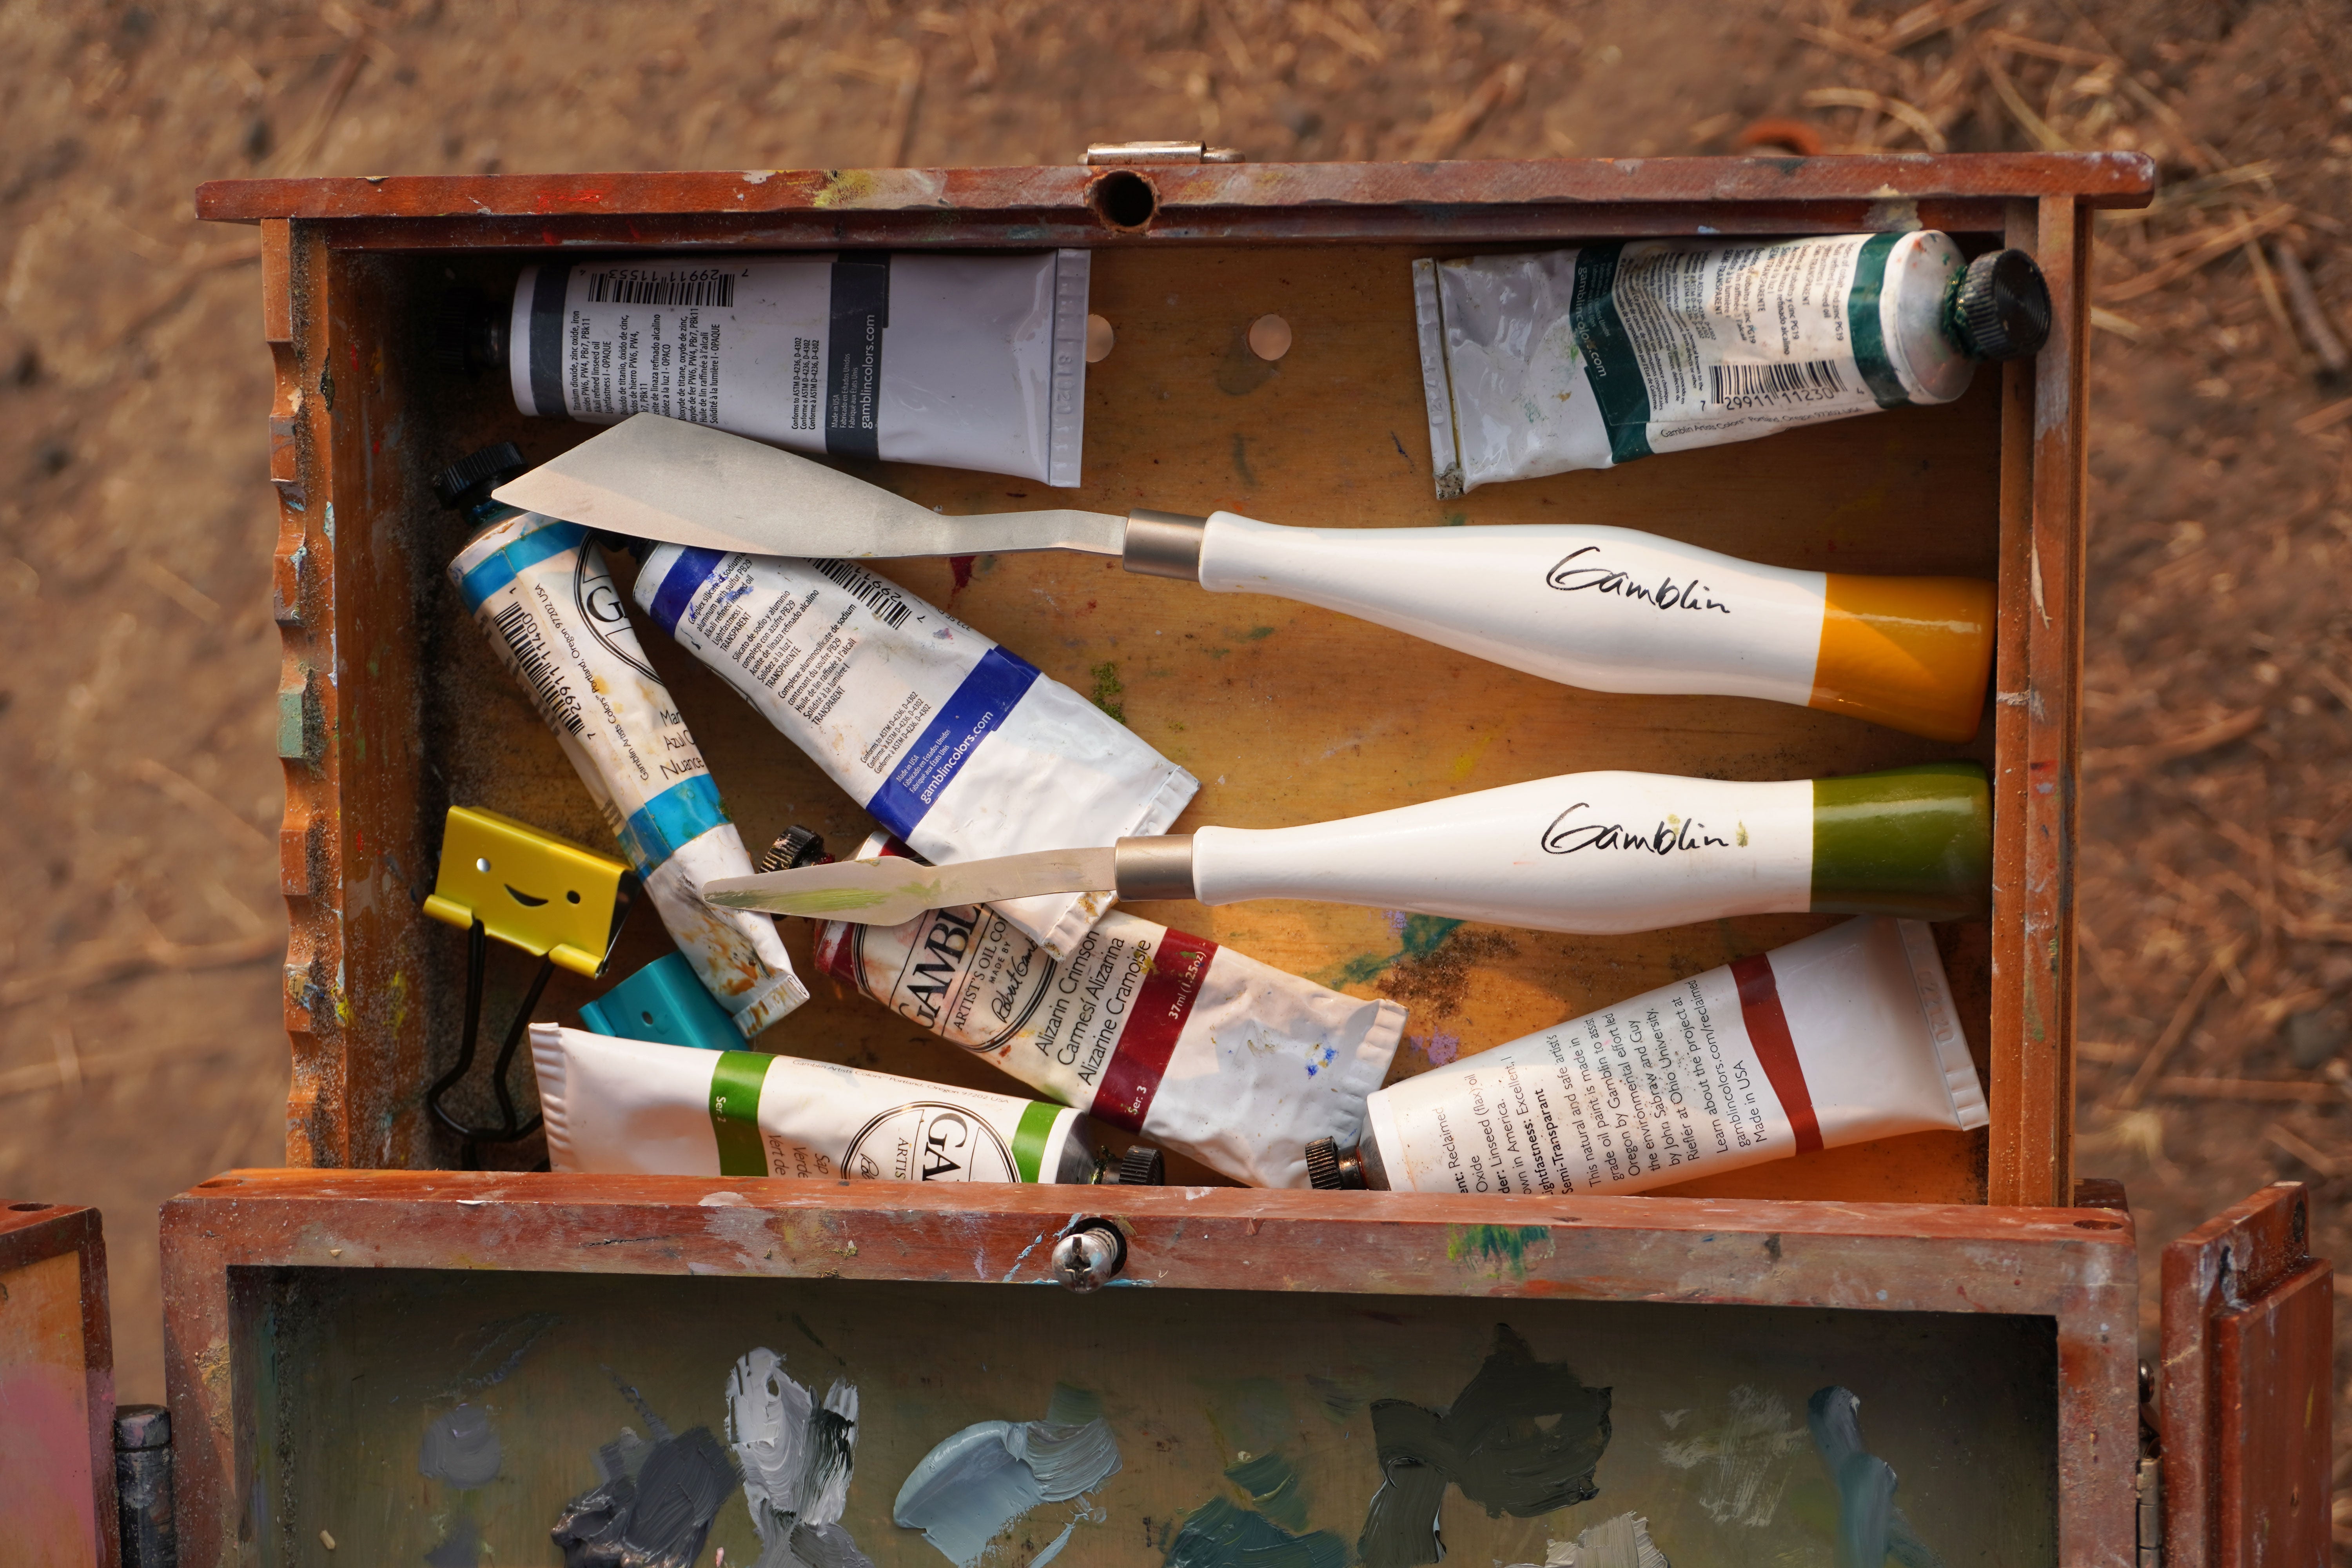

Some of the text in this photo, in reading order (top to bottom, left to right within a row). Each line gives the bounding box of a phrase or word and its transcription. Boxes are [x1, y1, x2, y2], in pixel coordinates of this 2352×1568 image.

[609, 269, 658, 282] 11553
[669, 269, 720, 282] 29911
[1576, 266, 1608, 377] gamblincolos.com
[601, 341, 612, 368] OPAQUE
[793, 337, 802, 358] D-4302
[698, 360, 708, 387] raffinée
[793, 358, 802, 380] D-4236,
[860, 315, 875, 430] gamblincolors.com
[603, 377, 614, 414] Lightfastness
[698, 388, 707, 397] lin
[698, 398, 707, 407] de
[832, 394, 840, 405] USA
[1700, 400, 1706, 412] 7
[1725, 393, 1774, 410] 29911
[1781, 385, 1835, 404] 11230
[698, 408, 708, 423] Huile
[791, 404, 799, 429] Conforms
[534, 583, 548, 603] USA
[855, 567, 902, 603] 29911
[1546, 546, 1731, 613] Gamblin
[544, 601, 563, 629] 97202
[586, 586, 624, 622] G
[916, 615, 926, 623] 7
[519, 613, 551, 659] 11400
[561, 628, 580, 659] Oregon
[719, 611, 751, 652] TRANSPARENT
[732, 590, 790, 662] Silicato de sodio y aluminio
[577, 658, 599, 693] Portland,
[764, 646, 801, 689] TRANSPARENTE
[549, 666, 581, 715] 29911
[811, 685, 845, 725] TRANSPARENT
[614, 724, 631, 747] Artists
[663, 732, 687, 751] Azul
[628, 747, 649, 781] Gamblin
[659, 757, 704, 780] Nuance
[895, 768, 909, 782] Made
[908, 754, 920, 766] USA
[902, 766, 922, 788] Fabricado
[922, 744, 939, 762] Estados
[935, 729, 951, 745] Unidos
[920, 711, 993, 804] gamblincolors.com
[1541, 802, 1729, 855] Gamblin
[898, 902, 986, 1029] GAMBL
[988, 941, 1011, 984] MADE BY
[953, 971, 985, 1032] ARTIST'S
[978, 946, 997, 969] OIL
[1034, 929, 1100, 1057] Alizarin Crimson
[1056, 937, 1125, 1065] Carmesí Alizarina
[1168, 951, 1207, 1020] 37ml (1.25oz)
[1077, 940, 1151, 1086] Alizarine Cramoisie
[792, 1060, 826, 1069] Gamblin
[889, 1077, 923, 1087] Portland,
[927, 1085, 959, 1094] Oregon
[962, 1091, 988, 1100] 97202
[1646, 1008, 1700, 1161] Riefler at Ohio University.
[1671, 996, 1728, 1153] Learn about the project at
[1685, 980, 1751, 1147] gamblincolors.com/reclaimed
[715, 1096, 726, 1114] Ser.
[1127, 1085, 1147, 1115] Ser. 3
[1504, 1061, 1529, 1116] Excellent,
[1569, 1037, 1625, 1181] grade oil paint is made in
[1584, 1017, 1641, 1176] Oregon by Gamblin to assist
[1601, 1013, 1661, 1172] the environmental effort led
[1628, 1020, 1681, 1167] by John Sabraw and Guy
[1733, 1060, 1767, 1143] Made in USA
[1546, 1034, 1601, 1188] This natural and safe artist's
[922, 1112, 968, 1181] GA
[1432, 1106, 1468, 1193] ent: Reclaimed
[1464, 1073, 1510, 1194] der: Linseed (flax) oil
[1497, 1098, 1532, 1194] own in America.
[1534, 1088, 1573, 1194] Semi-Transparant
[769, 1134, 789, 1176] Vert de
[793, 1147, 811, 1178] Verde
[814, 1153, 831, 1175] Sap
[895, 1136, 909, 1181] ARTIS
[1469, 1155, 1488, 1193] Oxide
[1523, 1118, 1555, 1194] ightfastness:
